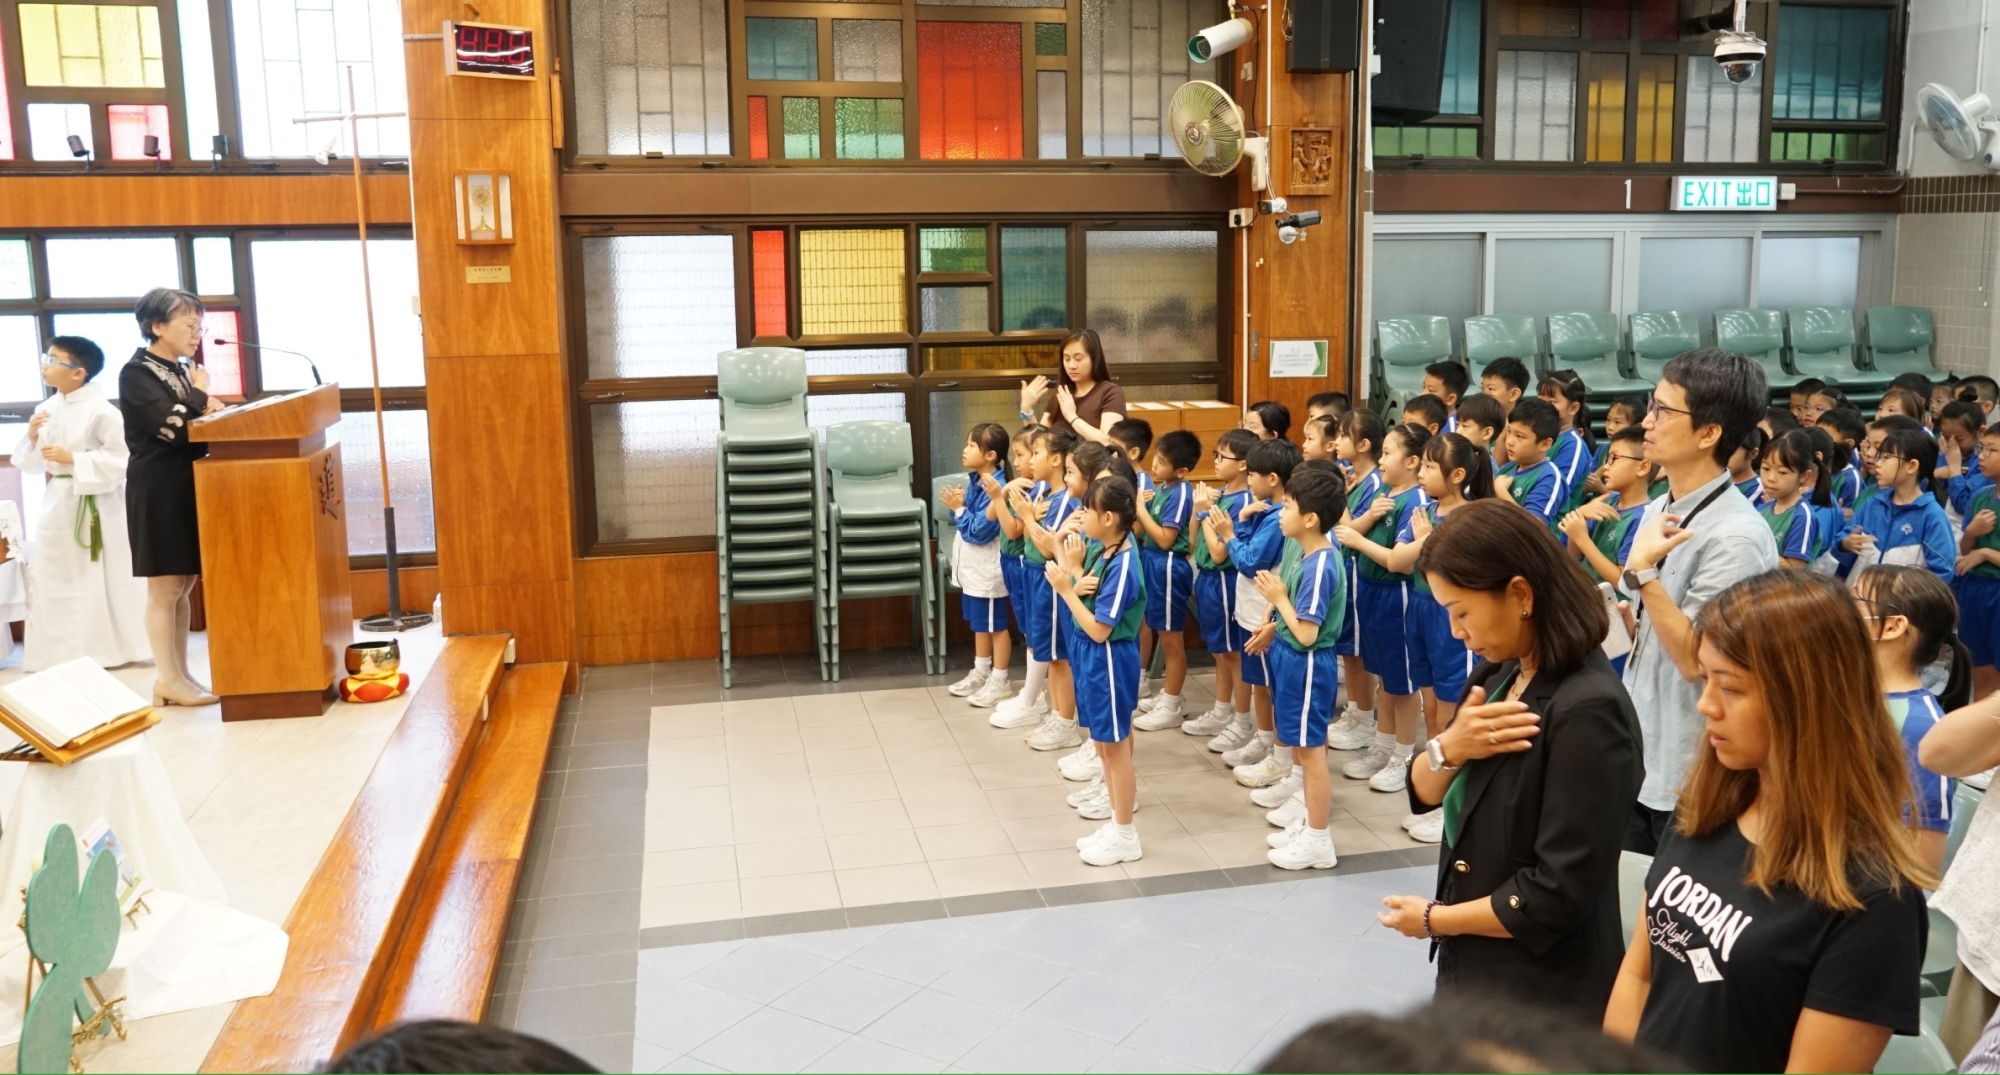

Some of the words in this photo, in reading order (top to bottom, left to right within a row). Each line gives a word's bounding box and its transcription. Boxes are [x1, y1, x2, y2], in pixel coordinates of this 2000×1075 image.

[1624, 179, 1632, 209] 1
[1683, 181, 1731, 206] EXIT
[1736, 181, 1770, 206] 出口
[1648, 866, 1753, 962] JORDAN
[1656, 908, 1693, 947] Flight
